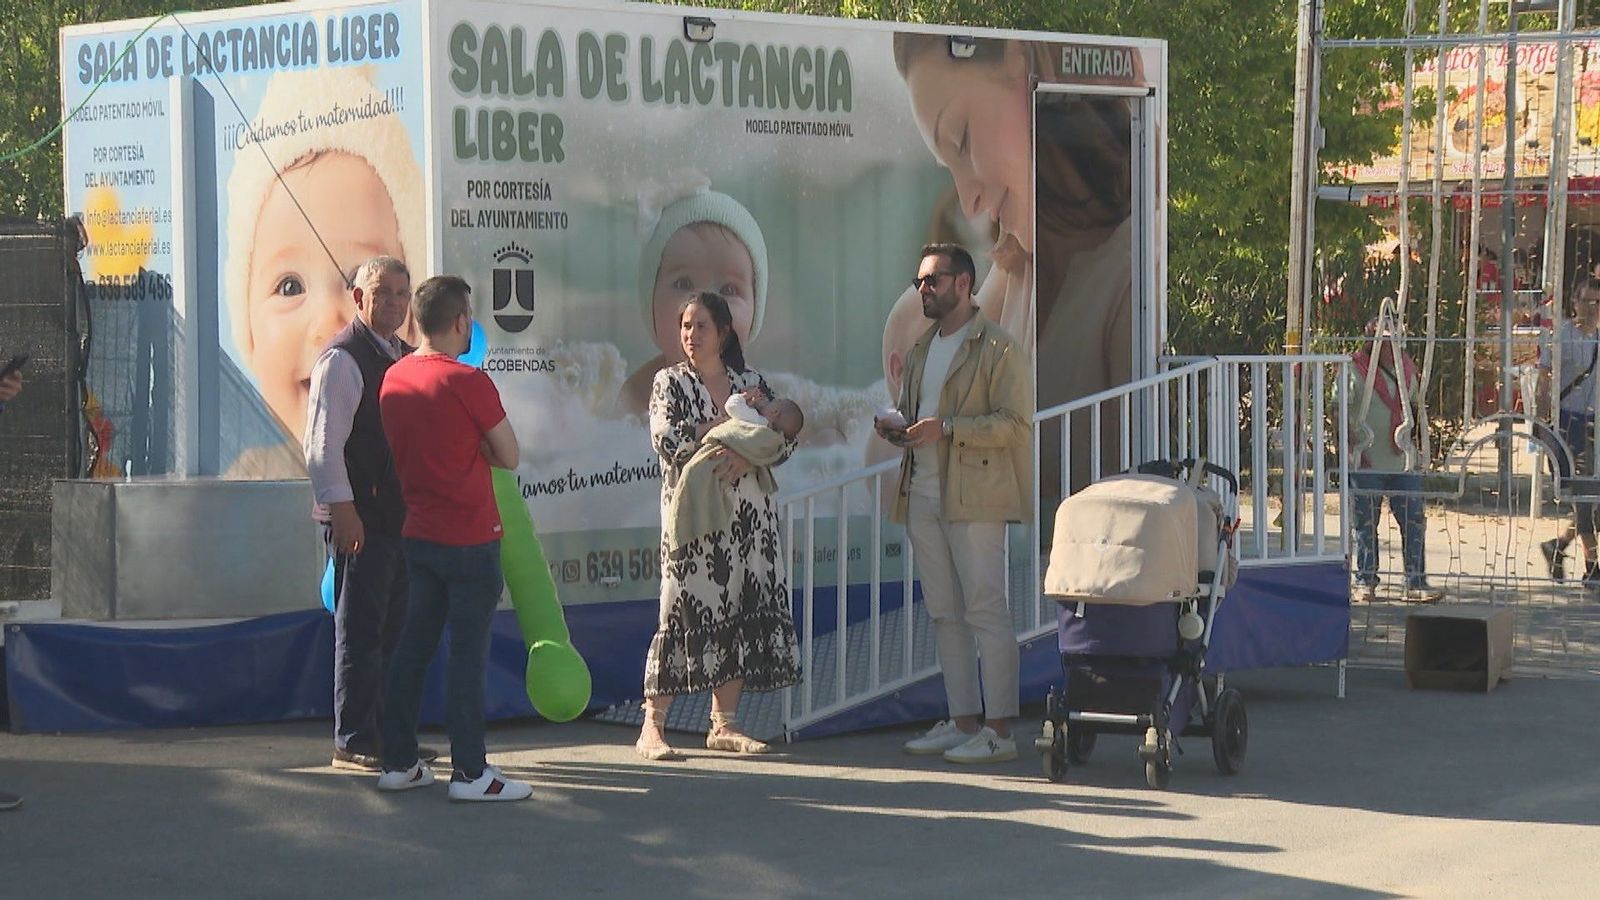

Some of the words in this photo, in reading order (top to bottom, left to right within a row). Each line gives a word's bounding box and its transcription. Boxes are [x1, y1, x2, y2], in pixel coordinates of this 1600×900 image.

[78, 39, 138, 85] SALA
[146, 35, 174, 79] DE
[181, 20, 318, 76] LACTANCIA
[327, 12, 400, 63] LIBER
[449, 23, 565, 98] SALA
[577, 31, 628, 100] DE
[641, 37, 853, 113] LACTANCIA
[1061, 46, 1134, 77] ENTRADA
[69, 105, 98, 122] MODELO
[99, 102, 141, 121] PATENTADO
[142, 97, 165, 118] MÓVIL
[298, 109, 314, 133] tu
[315, 86, 405, 129] maternidad!!!
[454, 108, 566, 164] LIBER
[745, 119, 780, 134] MODELO
[781, 120, 828, 137] PATENTADO
[829, 120, 854, 138] MÓVIL
[93, 147, 108, 163] POR
[109, 141, 144, 162] CORTESÍA
[84, 172, 98, 188] DEL
[99, 169, 155, 187] AYUNTAMIENTO
[467, 180, 491, 199] POR
[493, 178, 552, 200] CORTESÍA
[451, 208, 474, 228] DEL
[477, 209, 568, 230] AYUNTAMIENTO
[487, 346, 535, 357] yuntamiento
[481, 359, 556, 372] LCOBENDAS
[567, 467, 588, 491] tu
[590, 454, 662, 487] maternid
[586, 550, 624, 584] 639
